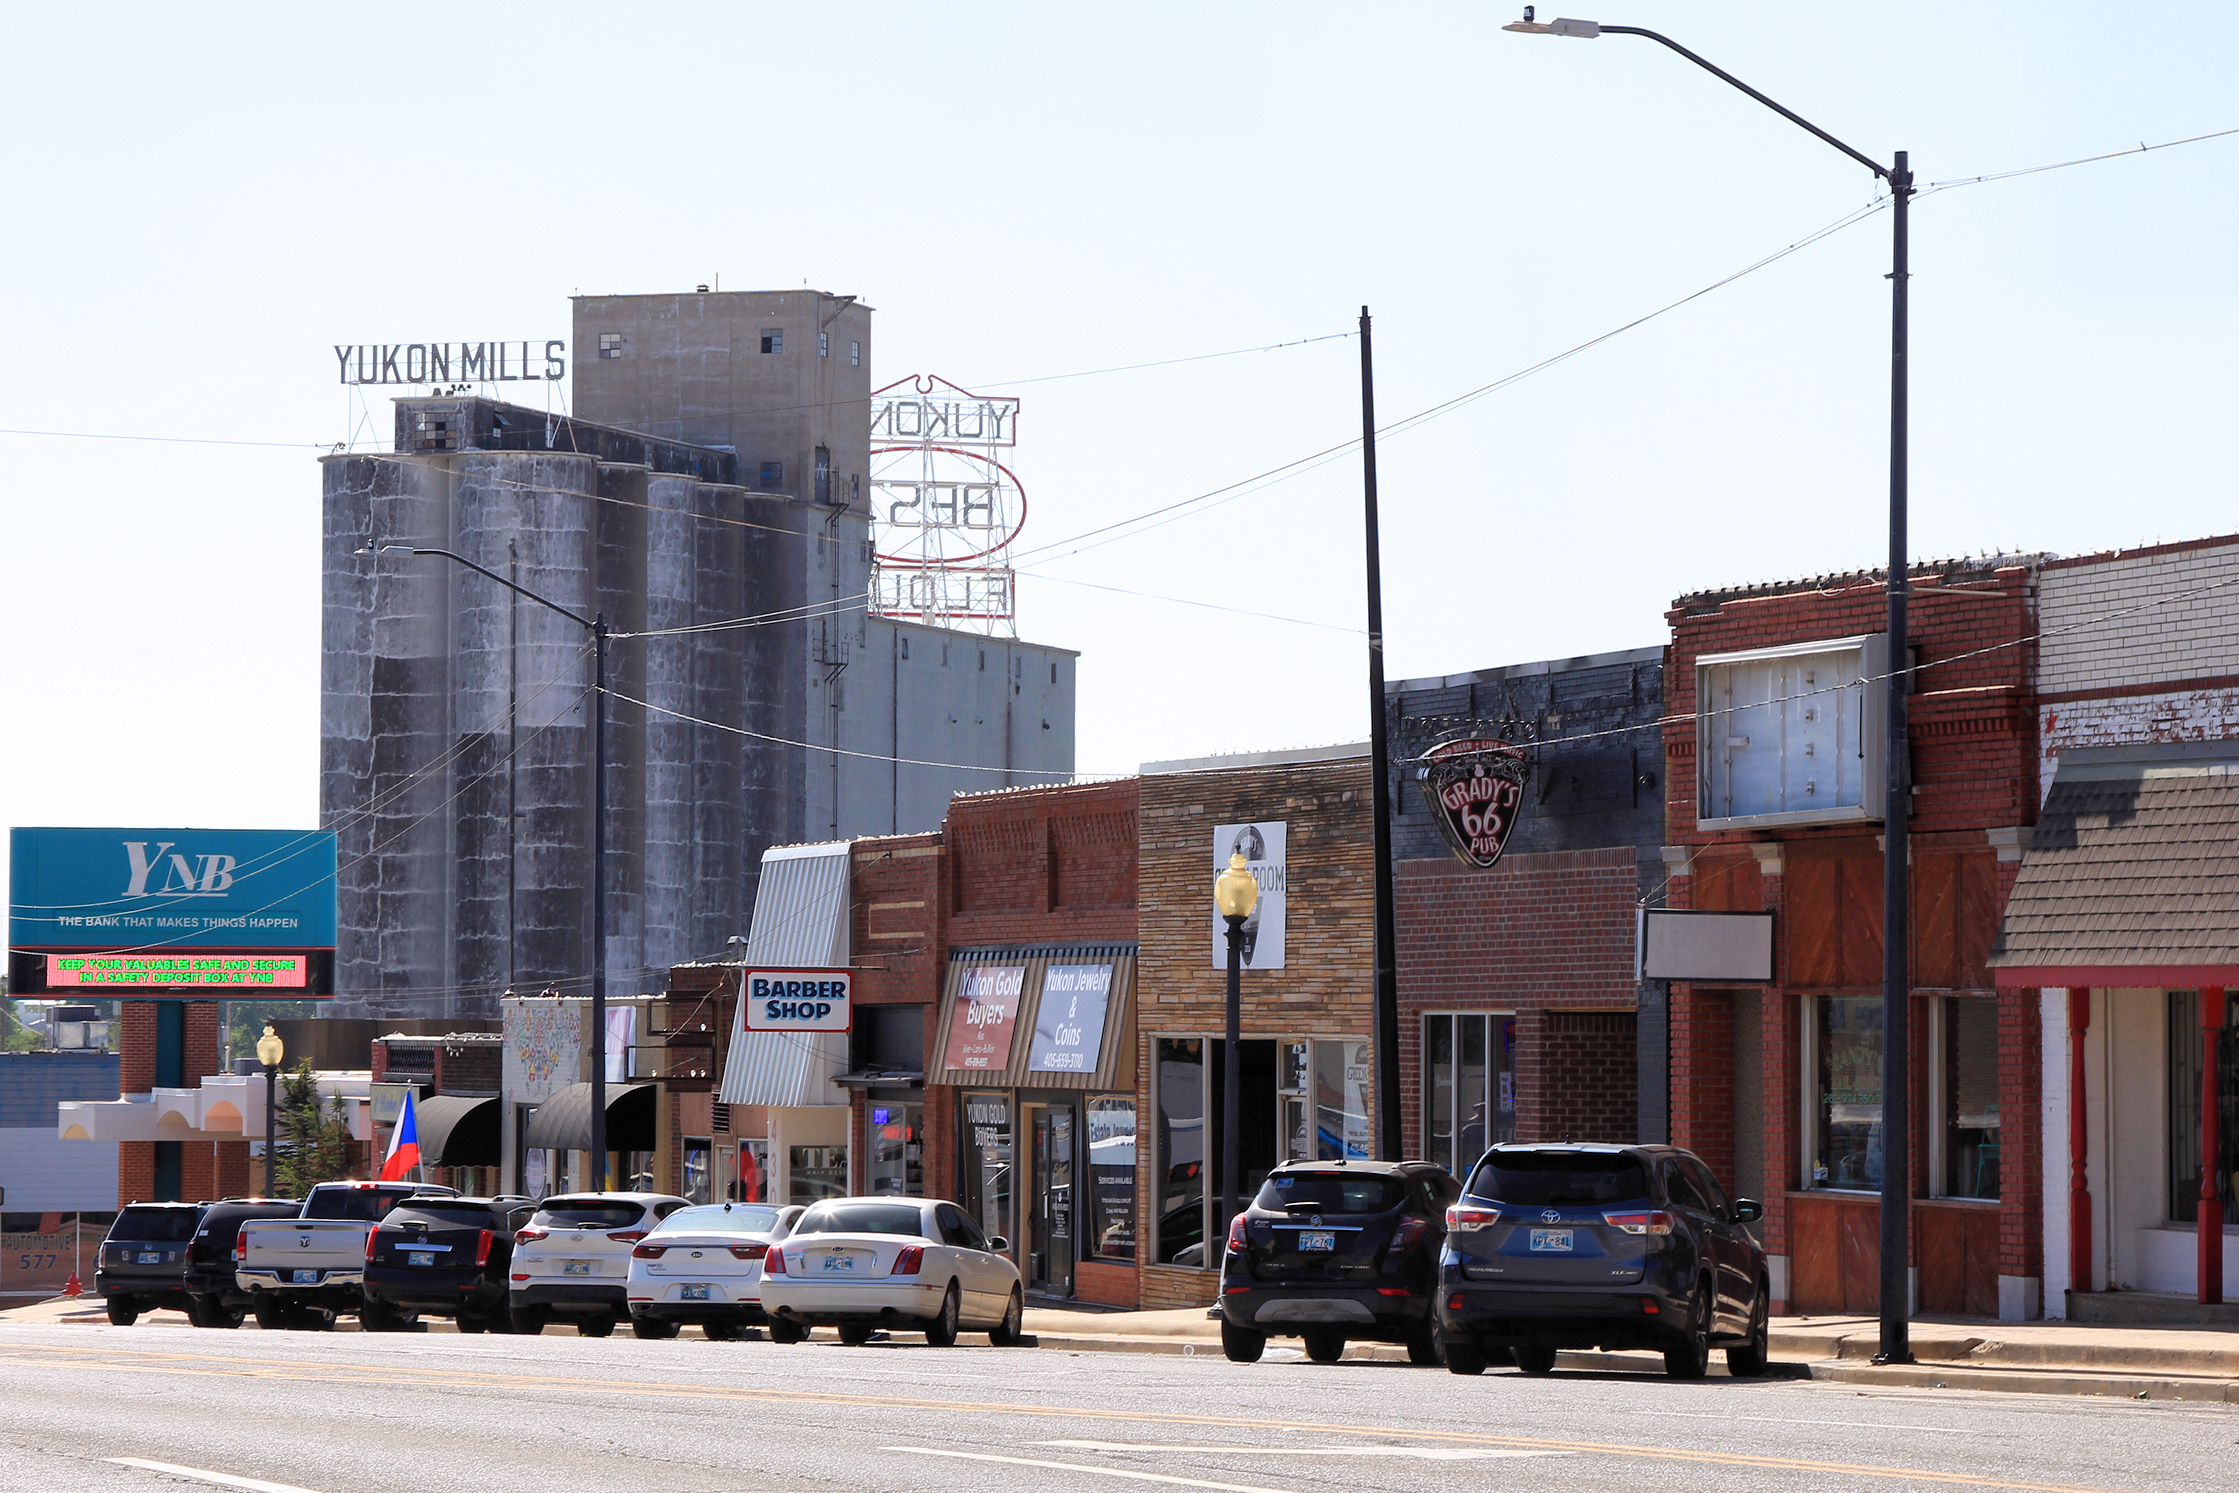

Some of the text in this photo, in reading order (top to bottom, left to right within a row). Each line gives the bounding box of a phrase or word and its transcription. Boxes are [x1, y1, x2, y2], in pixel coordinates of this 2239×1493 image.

[334, 340, 565, 384] YUKON MILLS
[1452, 742, 1473, 752] BEER
[1481, 741, 1499, 749] LIVE
[1500, 743, 1524, 759] MUSIC
[1442, 777, 1519, 810] GRADY'S
[1461, 802, 1502, 837] 66
[1470, 837, 1500, 854] PUB
[121, 841, 236, 897] YNB
[58, 916, 298, 929] THE BANK THAT MAKES THINGS HAPPEN
[58, 959, 296, 971] KEEP YOUR VALUABLES SAFE AND SECURE
[80, 972, 274, 983] IN A SAFETY DEPOSIT BOX AT YNB
[961, 969, 1026, 997] Yukon Gold
[1046, 968, 1112, 995] Yukon Jewelry
[752, 978, 846, 1000] BARBER
[765, 1000, 831, 1021] SHOP
[966, 1000, 1005, 1030] Buyers
[1068, 995, 1078, 1019] &
[1054, 1022, 1082, 1046] Coins
[1043, 1052, 1084, 1069] 405-659-3110
[966, 1103, 1006, 1124] YUKON GOLD
[974, 1126, 999, 1147] BUYERS
[6, 1235, 71, 1250] AUTOMOTIVE
[1532, 1236, 1570, 1247] KPX-841
[20, 1254, 57, 1270] 577
